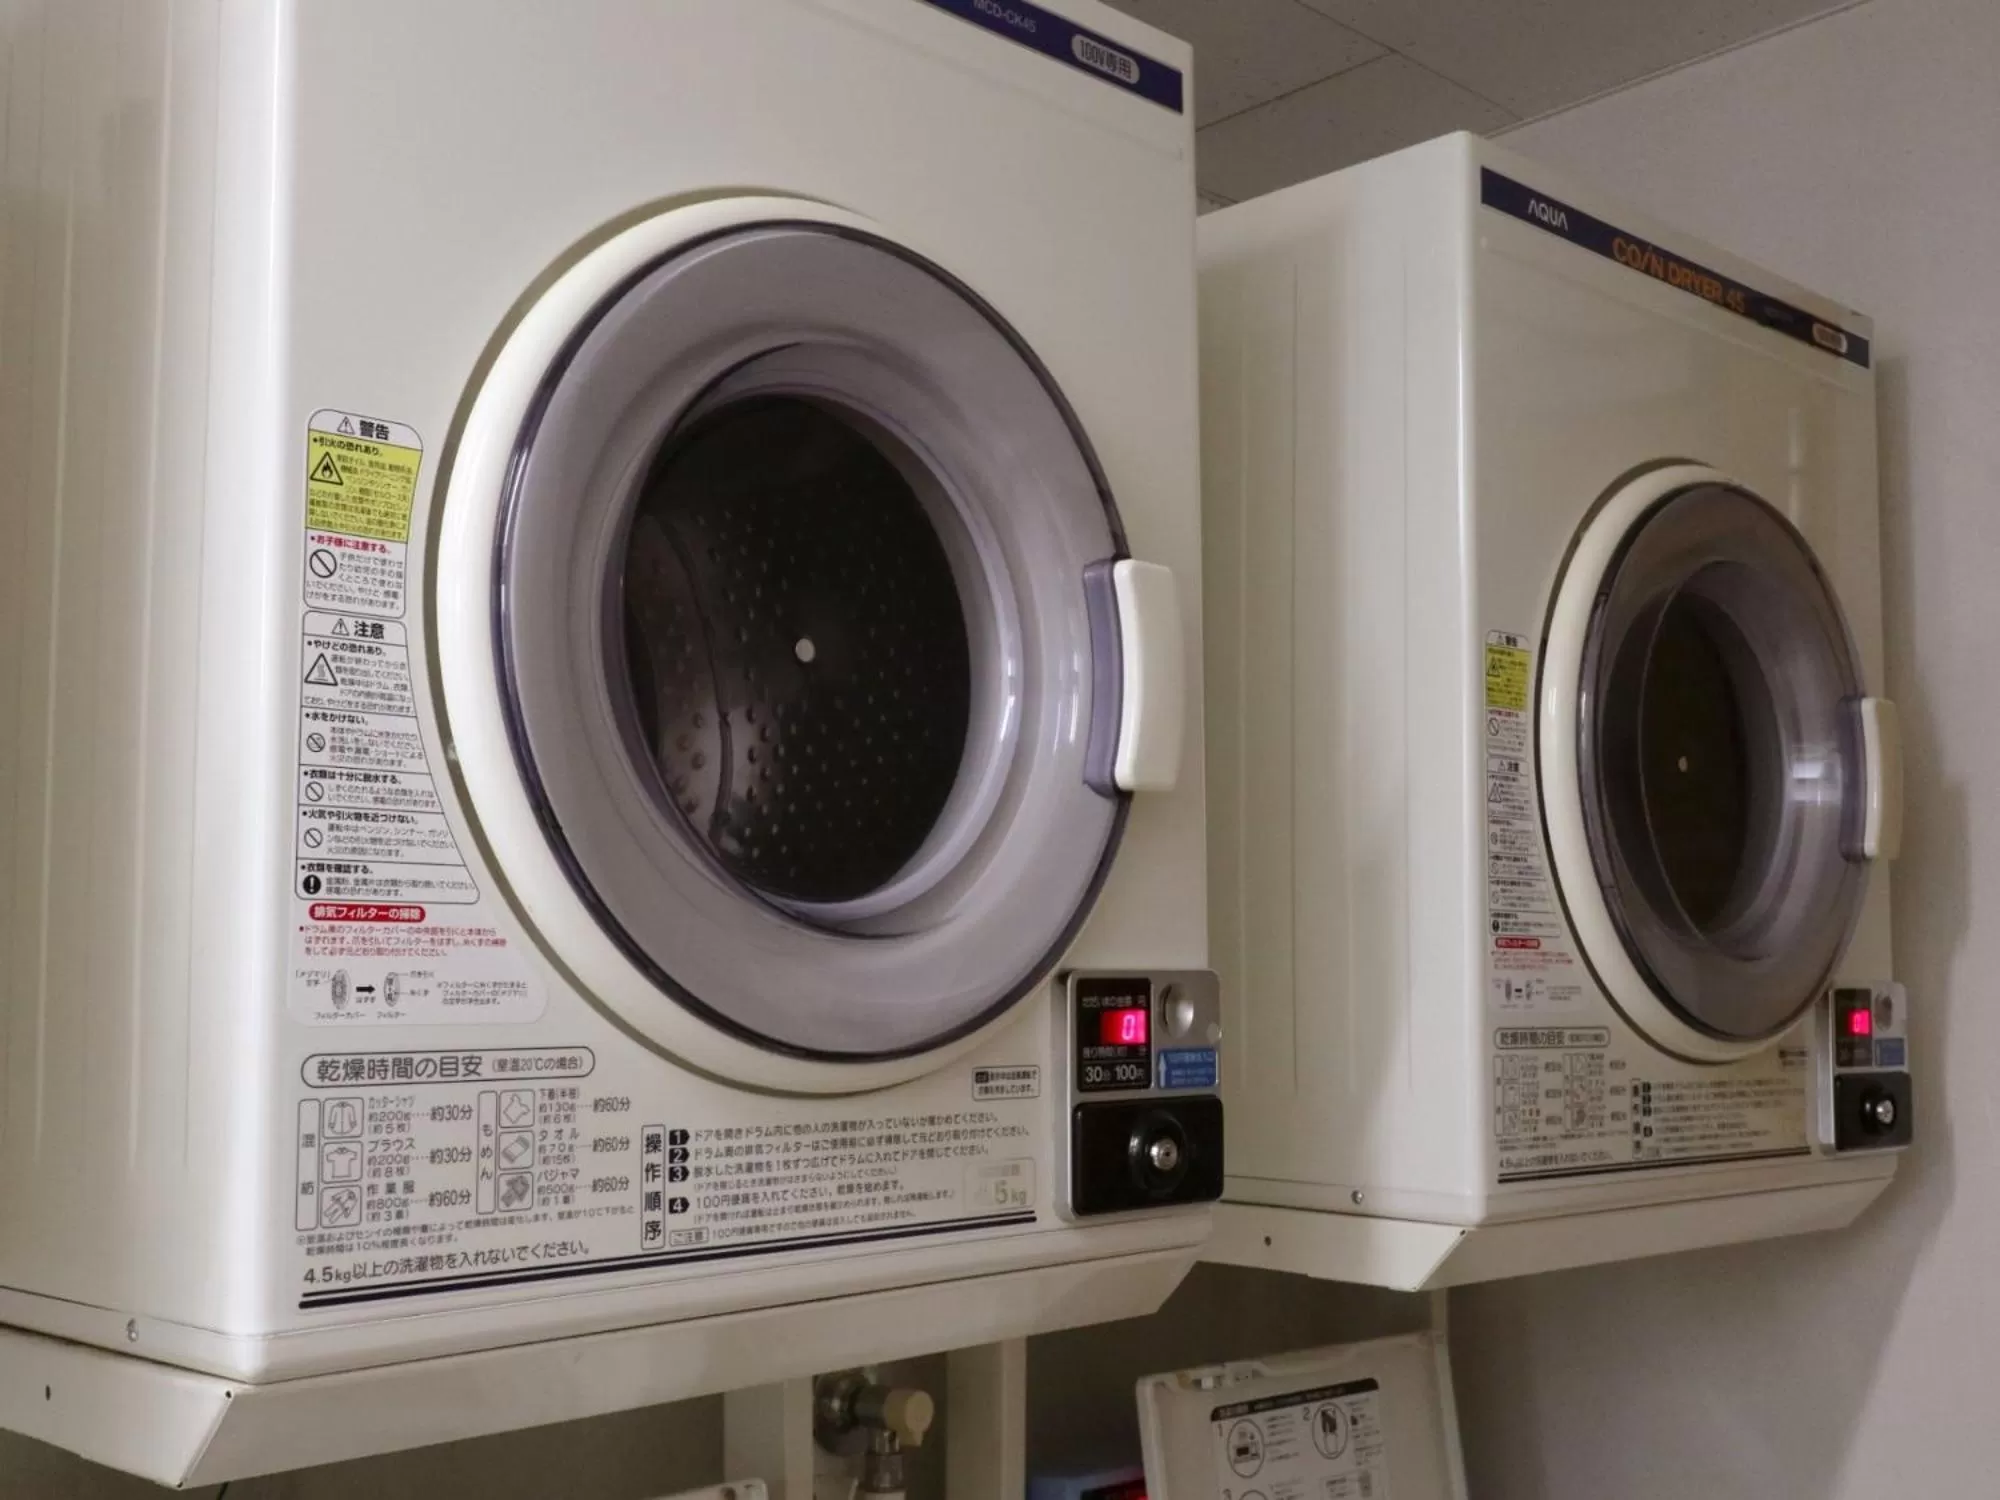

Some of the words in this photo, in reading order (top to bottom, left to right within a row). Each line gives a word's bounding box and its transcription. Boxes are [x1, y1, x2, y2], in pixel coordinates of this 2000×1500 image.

[1080, 38, 1132, 80] 100V専用
[1528, 199, 1567, 231] AQUA
[1668, 261, 1723, 305] DRYER
[360, 420, 389, 440] 警告
[317, 535, 391, 554] お子様に注意する。
[354, 621, 384, 640] 注意
[314, 640, 386, 657] やけどの恐れあり。
[312, 712, 368, 726] 水をかけない。
[309, 769, 402, 785] 衣類は十分に脱水する。
[308, 809, 418, 825] 火気や引火物を近づけない。
[307, 863, 373, 875] 衣類を確認する。
[313, 905, 421, 921] 排気フィルターの掃除
[1122, 1014, 1136, 1041] 0
[317, 1055, 482, 1082] 乾燥時間の目安
[430, 1104, 473, 1122] 約30分
[593, 1097, 631, 1113] 約60分
[539, 1128, 580, 1142] タオル
[368, 1138, 416, 1153] ブラウス
[480, 1124, 493, 1181] もめん
[592, 1136, 630, 1153] 約60分
[302, 1133, 316, 1196] 混紡
[429, 1148, 473, 1165] 約30分
[537, 1168, 580, 1183] パジャマ
[592, 1176, 630, 1193] 約60分
[644, 1134, 662, 1241] 操作順序
[428, 1190, 472, 1208] 約60分
[303, 1240, 590, 1284] 4.5kg以上の洗濯物を入れないでください。
[1302, 1406, 1312, 1422] 2
